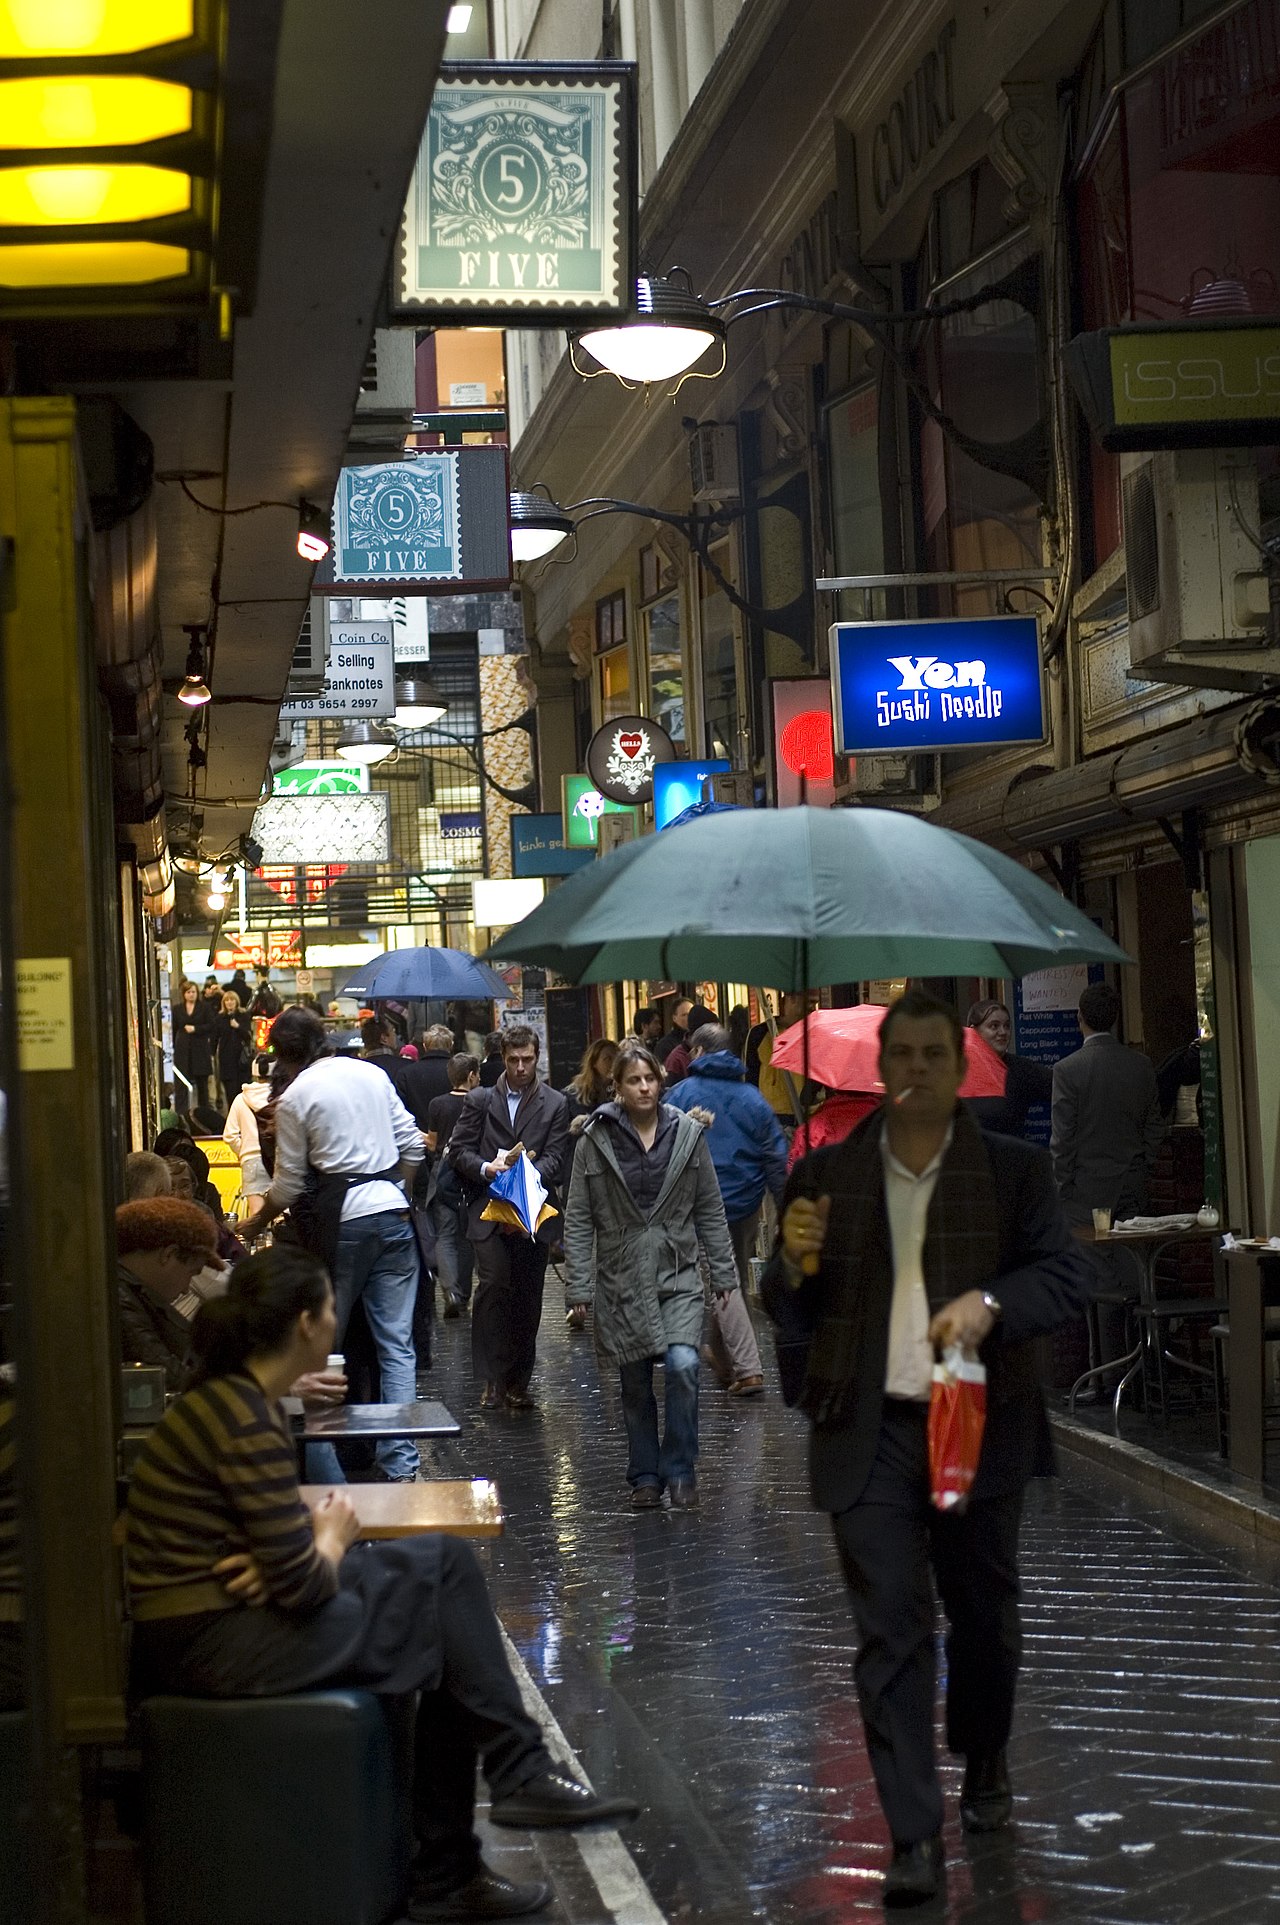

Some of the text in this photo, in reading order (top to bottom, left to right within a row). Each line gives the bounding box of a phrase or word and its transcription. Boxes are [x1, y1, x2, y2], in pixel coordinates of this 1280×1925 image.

[497, 153, 525, 203] 5
[459, 250, 559, 288] FIVE
[388, 494, 405, 524] 5
[366, 550, 428, 571] FIVE
[338, 633, 365, 643] Coin
[371, 632, 389, 643] Co.
[338, 654, 375, 670] Selling
[886, 655, 987, 690] Yen
[301, 700, 314, 709] 03
[318, 699, 346, 709] 9654
[352, 699, 378, 708] 2997
[876, 690, 930, 727] Sushi
[1033, 1012, 1054, 1020] White
[1019, 1026, 1061, 1035] Cappuccino
[1020, 1041, 1038, 1049] Long
[1039, 1040, 1059, 1048] Black
